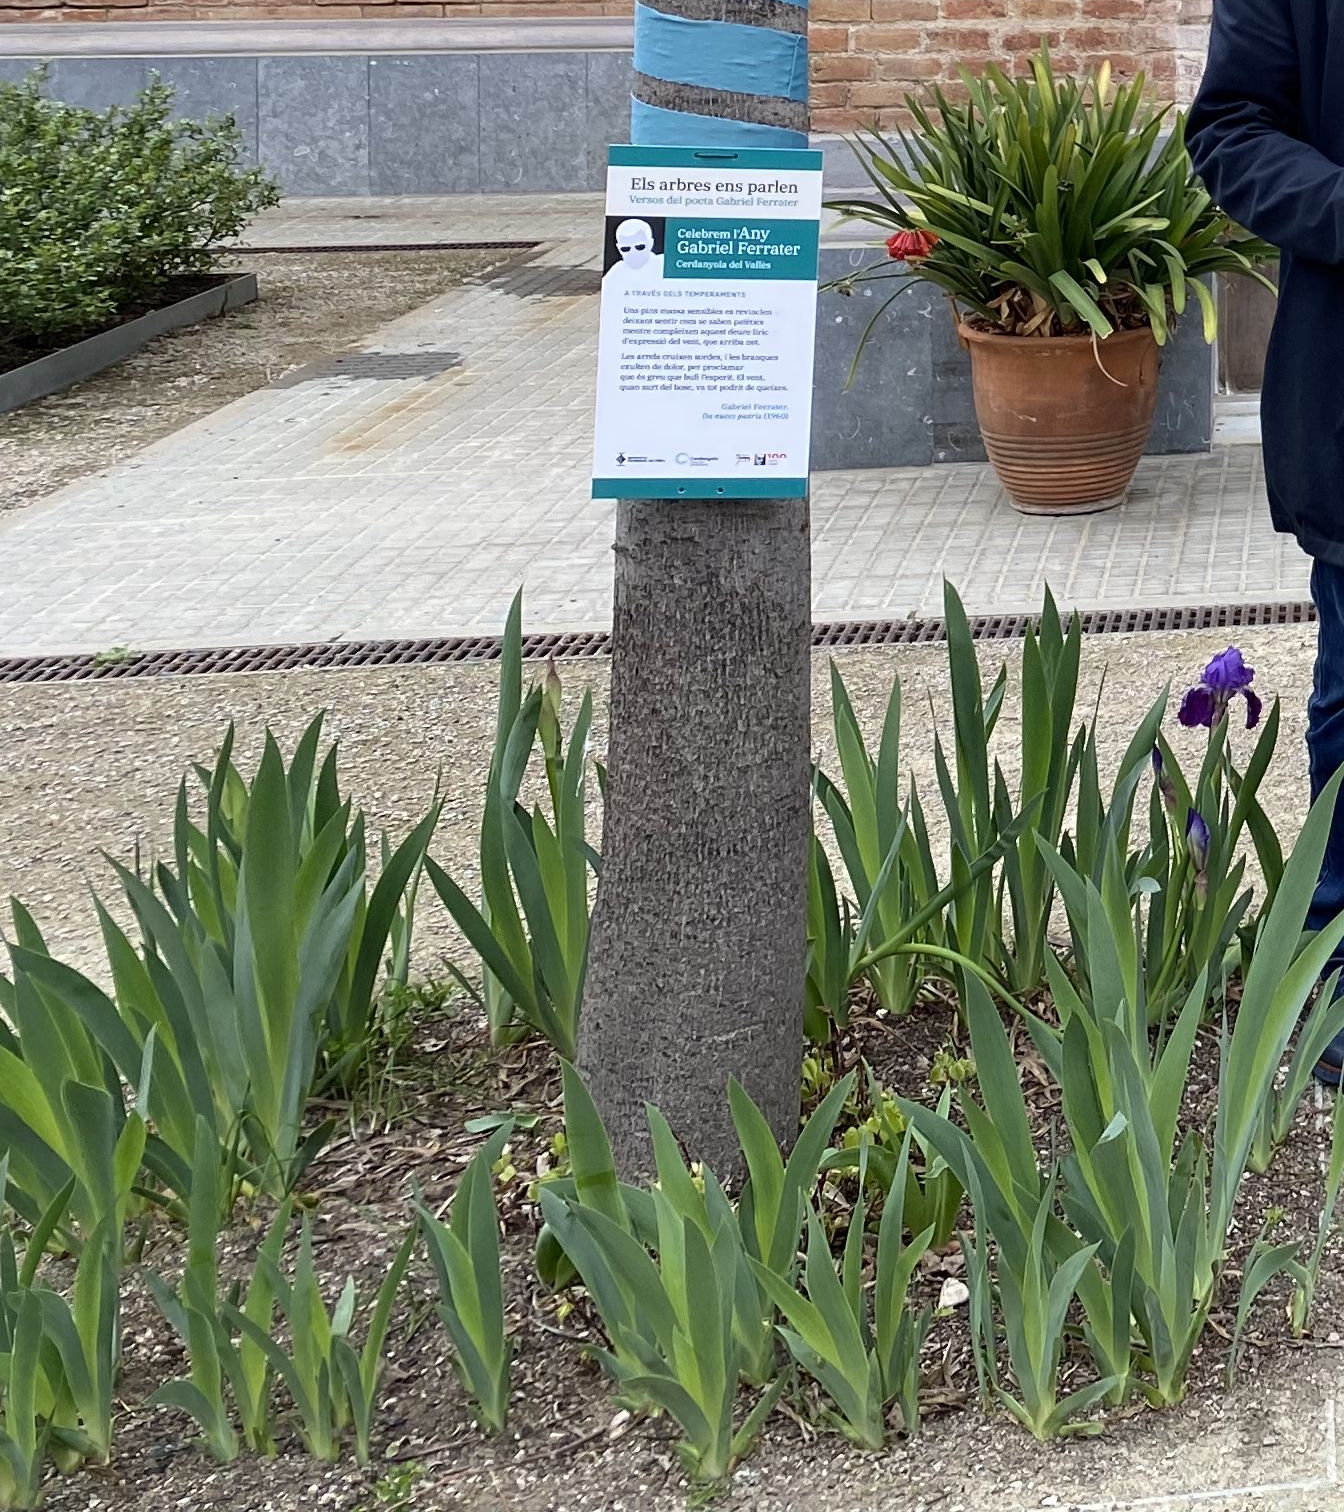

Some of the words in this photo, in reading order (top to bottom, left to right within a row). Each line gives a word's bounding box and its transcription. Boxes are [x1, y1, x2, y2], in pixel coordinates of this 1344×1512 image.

[631, 177, 654, 191] Els
[659, 178, 711, 191] arbres
[715, 182, 743, 192] ens
[748, 181, 798, 195] parlen
[629, 195, 664, 204] Versos
[667, 196, 682, 204] del
[716, 196, 753, 206] Gabriel
[756, 198, 798, 207] Ferrater
[677, 229, 730, 239] Celebrem
[734, 227, 770, 242] l'Any
[677, 241, 733, 254] Gabriel
[738, 242, 800, 256] Ferrater
[676, 260, 727, 270] Cerdanyola
[729, 260, 742, 268] del
